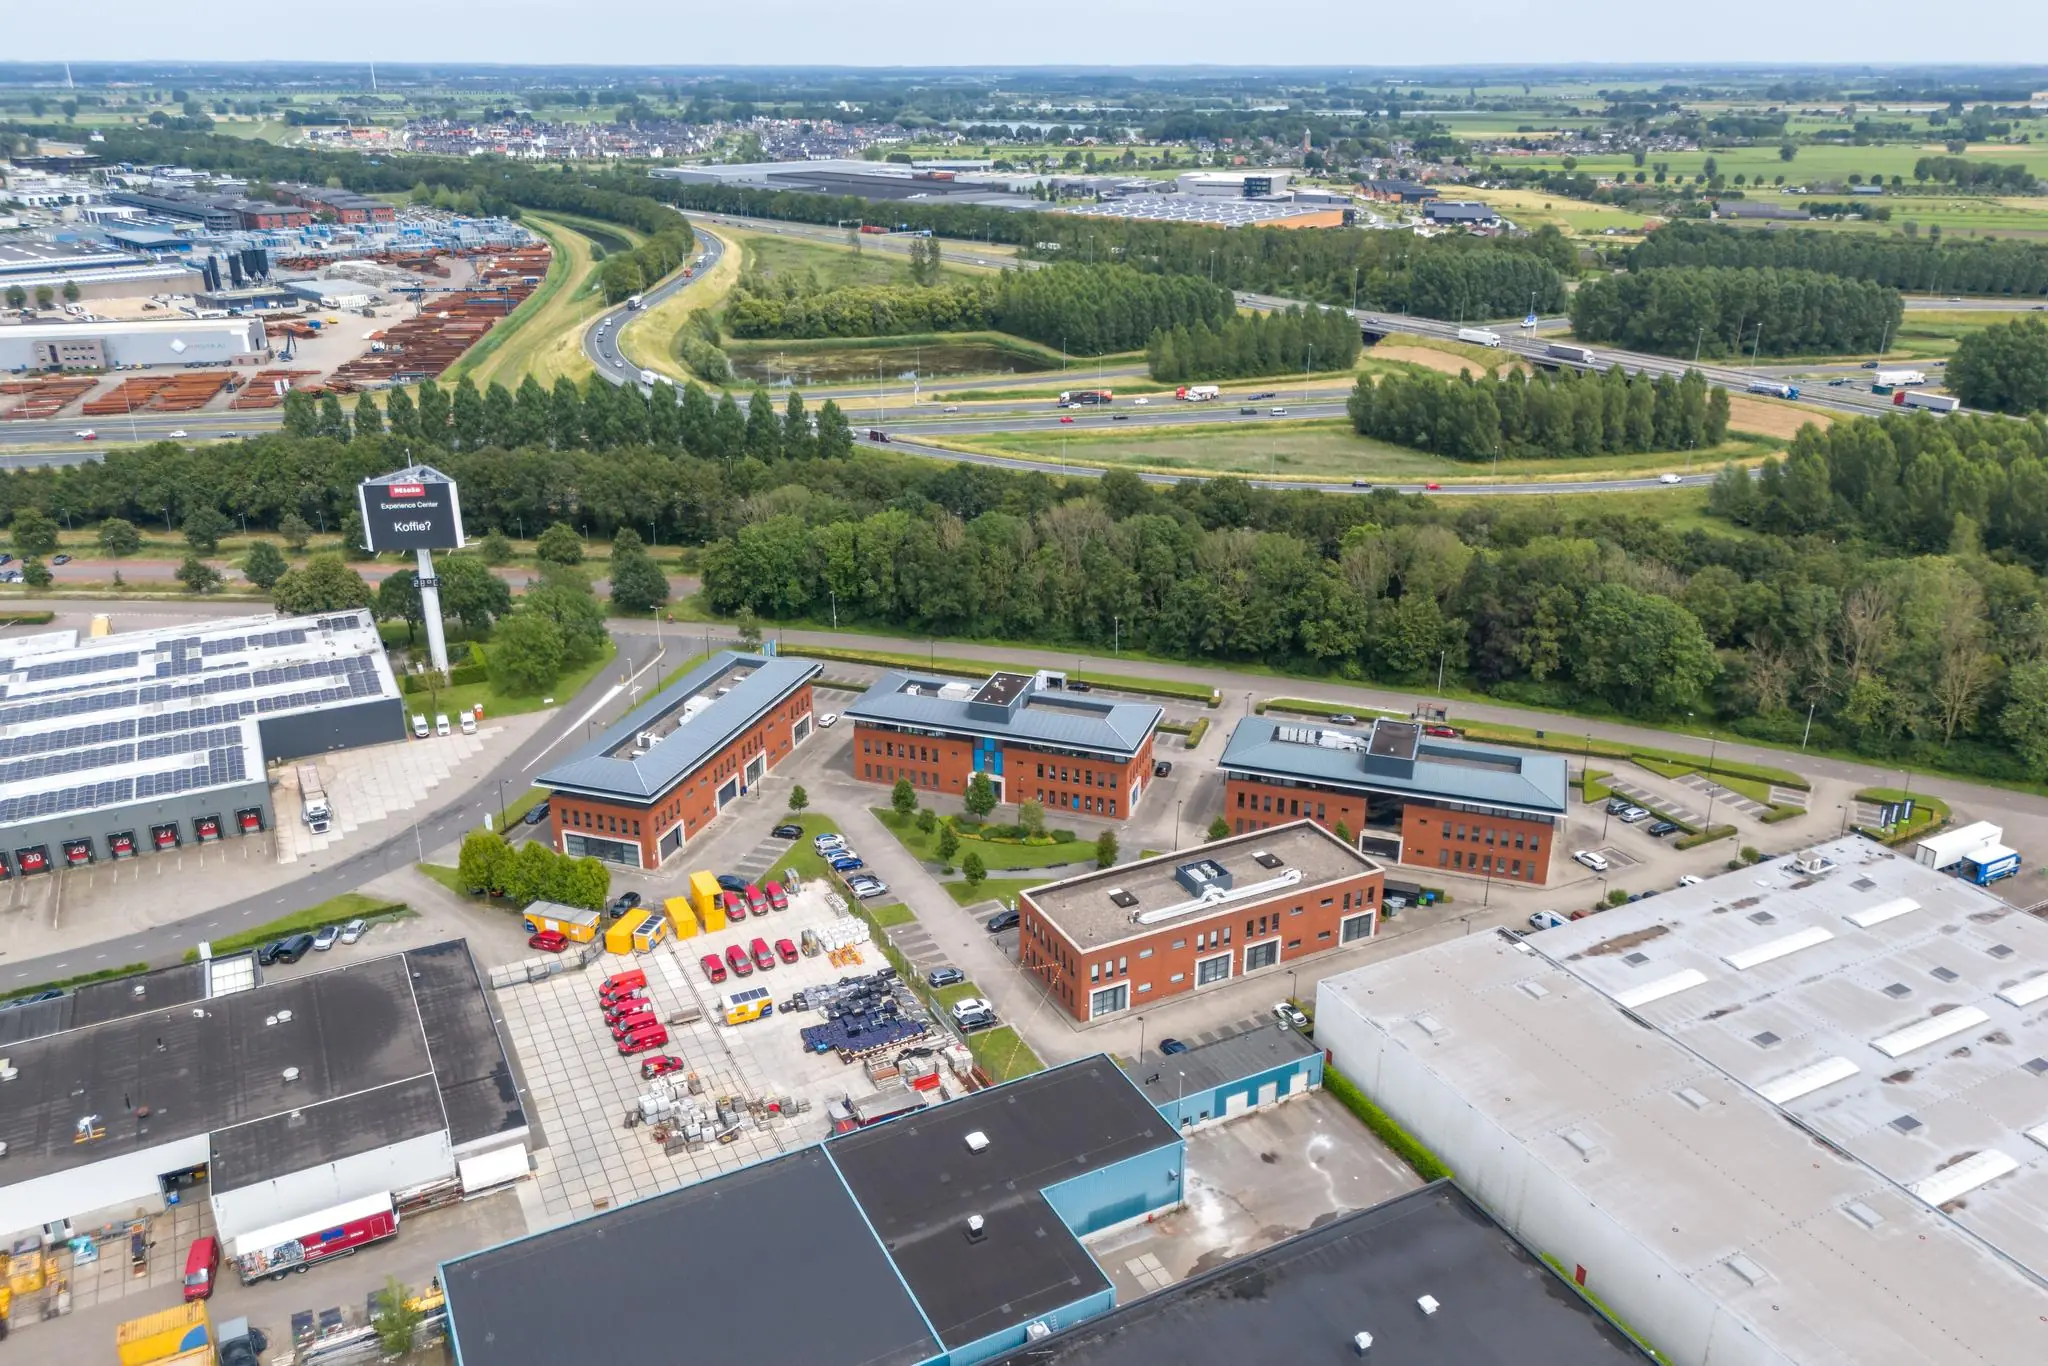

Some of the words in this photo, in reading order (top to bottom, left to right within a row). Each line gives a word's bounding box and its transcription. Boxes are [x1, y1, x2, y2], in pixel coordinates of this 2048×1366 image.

[381, 502, 416, 510] Experience
[394, 521, 431, 532] Koffie?
[71, 845, 86, 854] 29
[26, 853, 42, 863] 30
